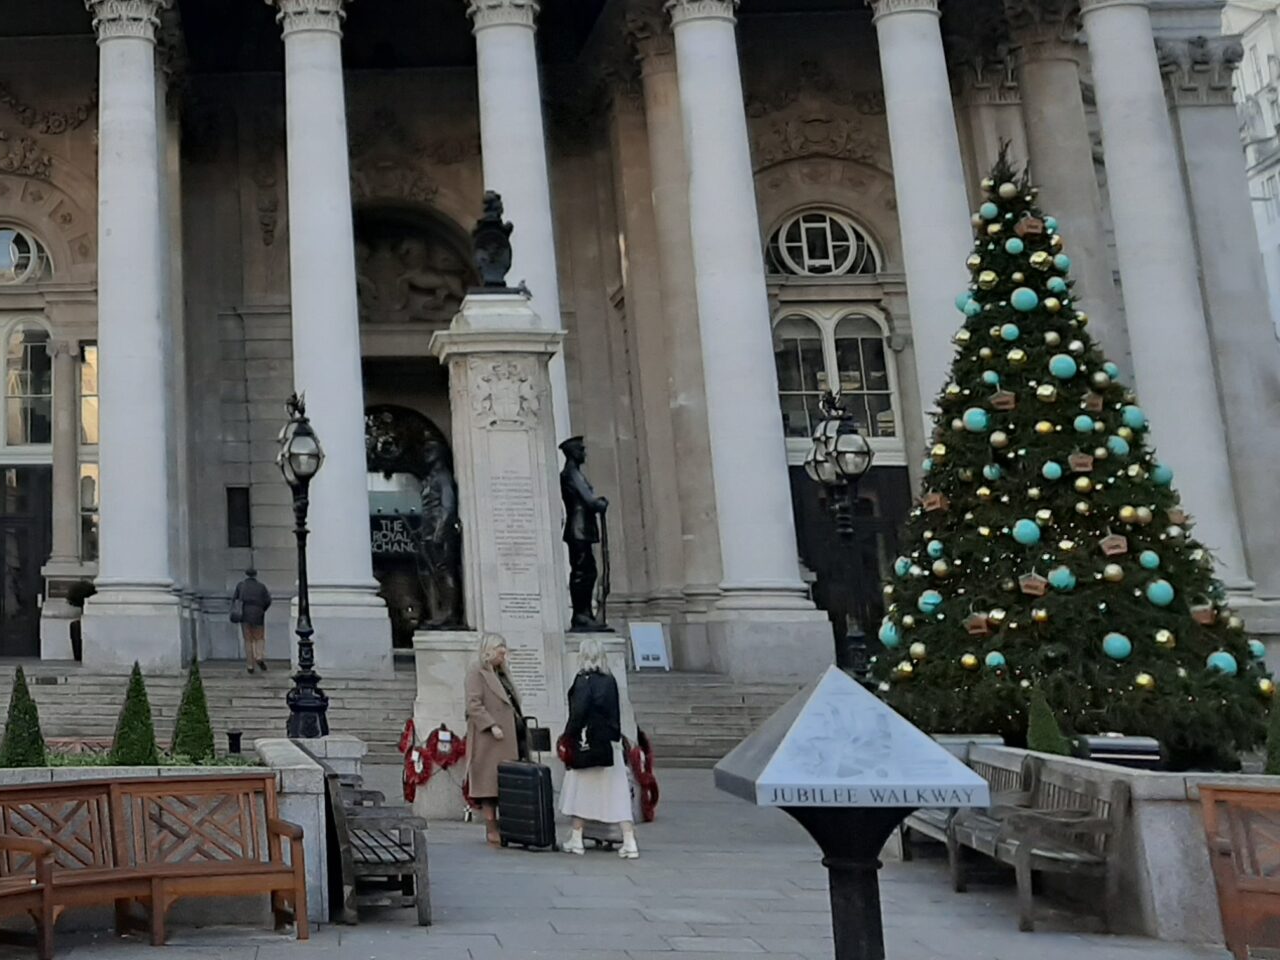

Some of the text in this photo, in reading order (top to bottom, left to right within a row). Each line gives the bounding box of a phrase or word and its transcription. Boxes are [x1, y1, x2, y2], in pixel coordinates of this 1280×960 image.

[380, 520, 404, 532] THE
[372, 530, 411, 542] ROYAL
[770, 787, 975, 804] JUBILEE WALKWAY
